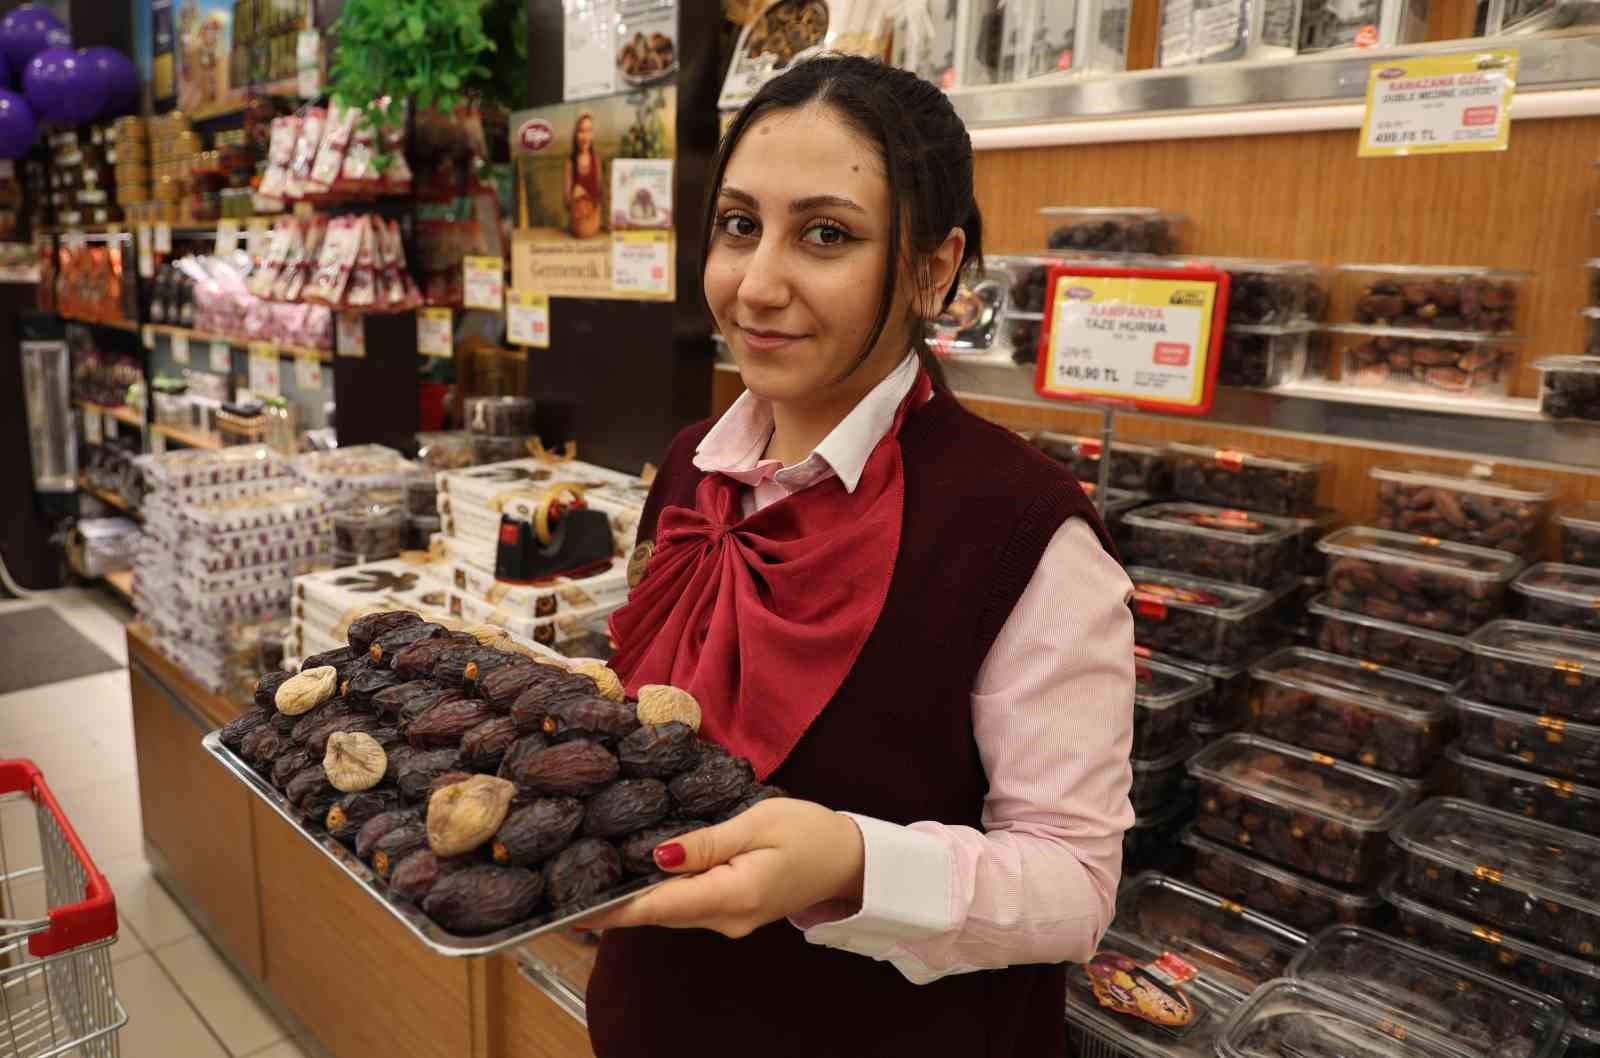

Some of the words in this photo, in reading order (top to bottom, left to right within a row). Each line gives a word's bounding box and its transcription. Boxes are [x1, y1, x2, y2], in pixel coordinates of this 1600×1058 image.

[1421, 129, 1437, 141] TL
[1088, 304, 1166, 319] KAMPANYA
[1085, 318, 1115, 331] TAZE
[1119, 321, 1168, 333] HURMA
[1104, 368, 1120, 383] TL
